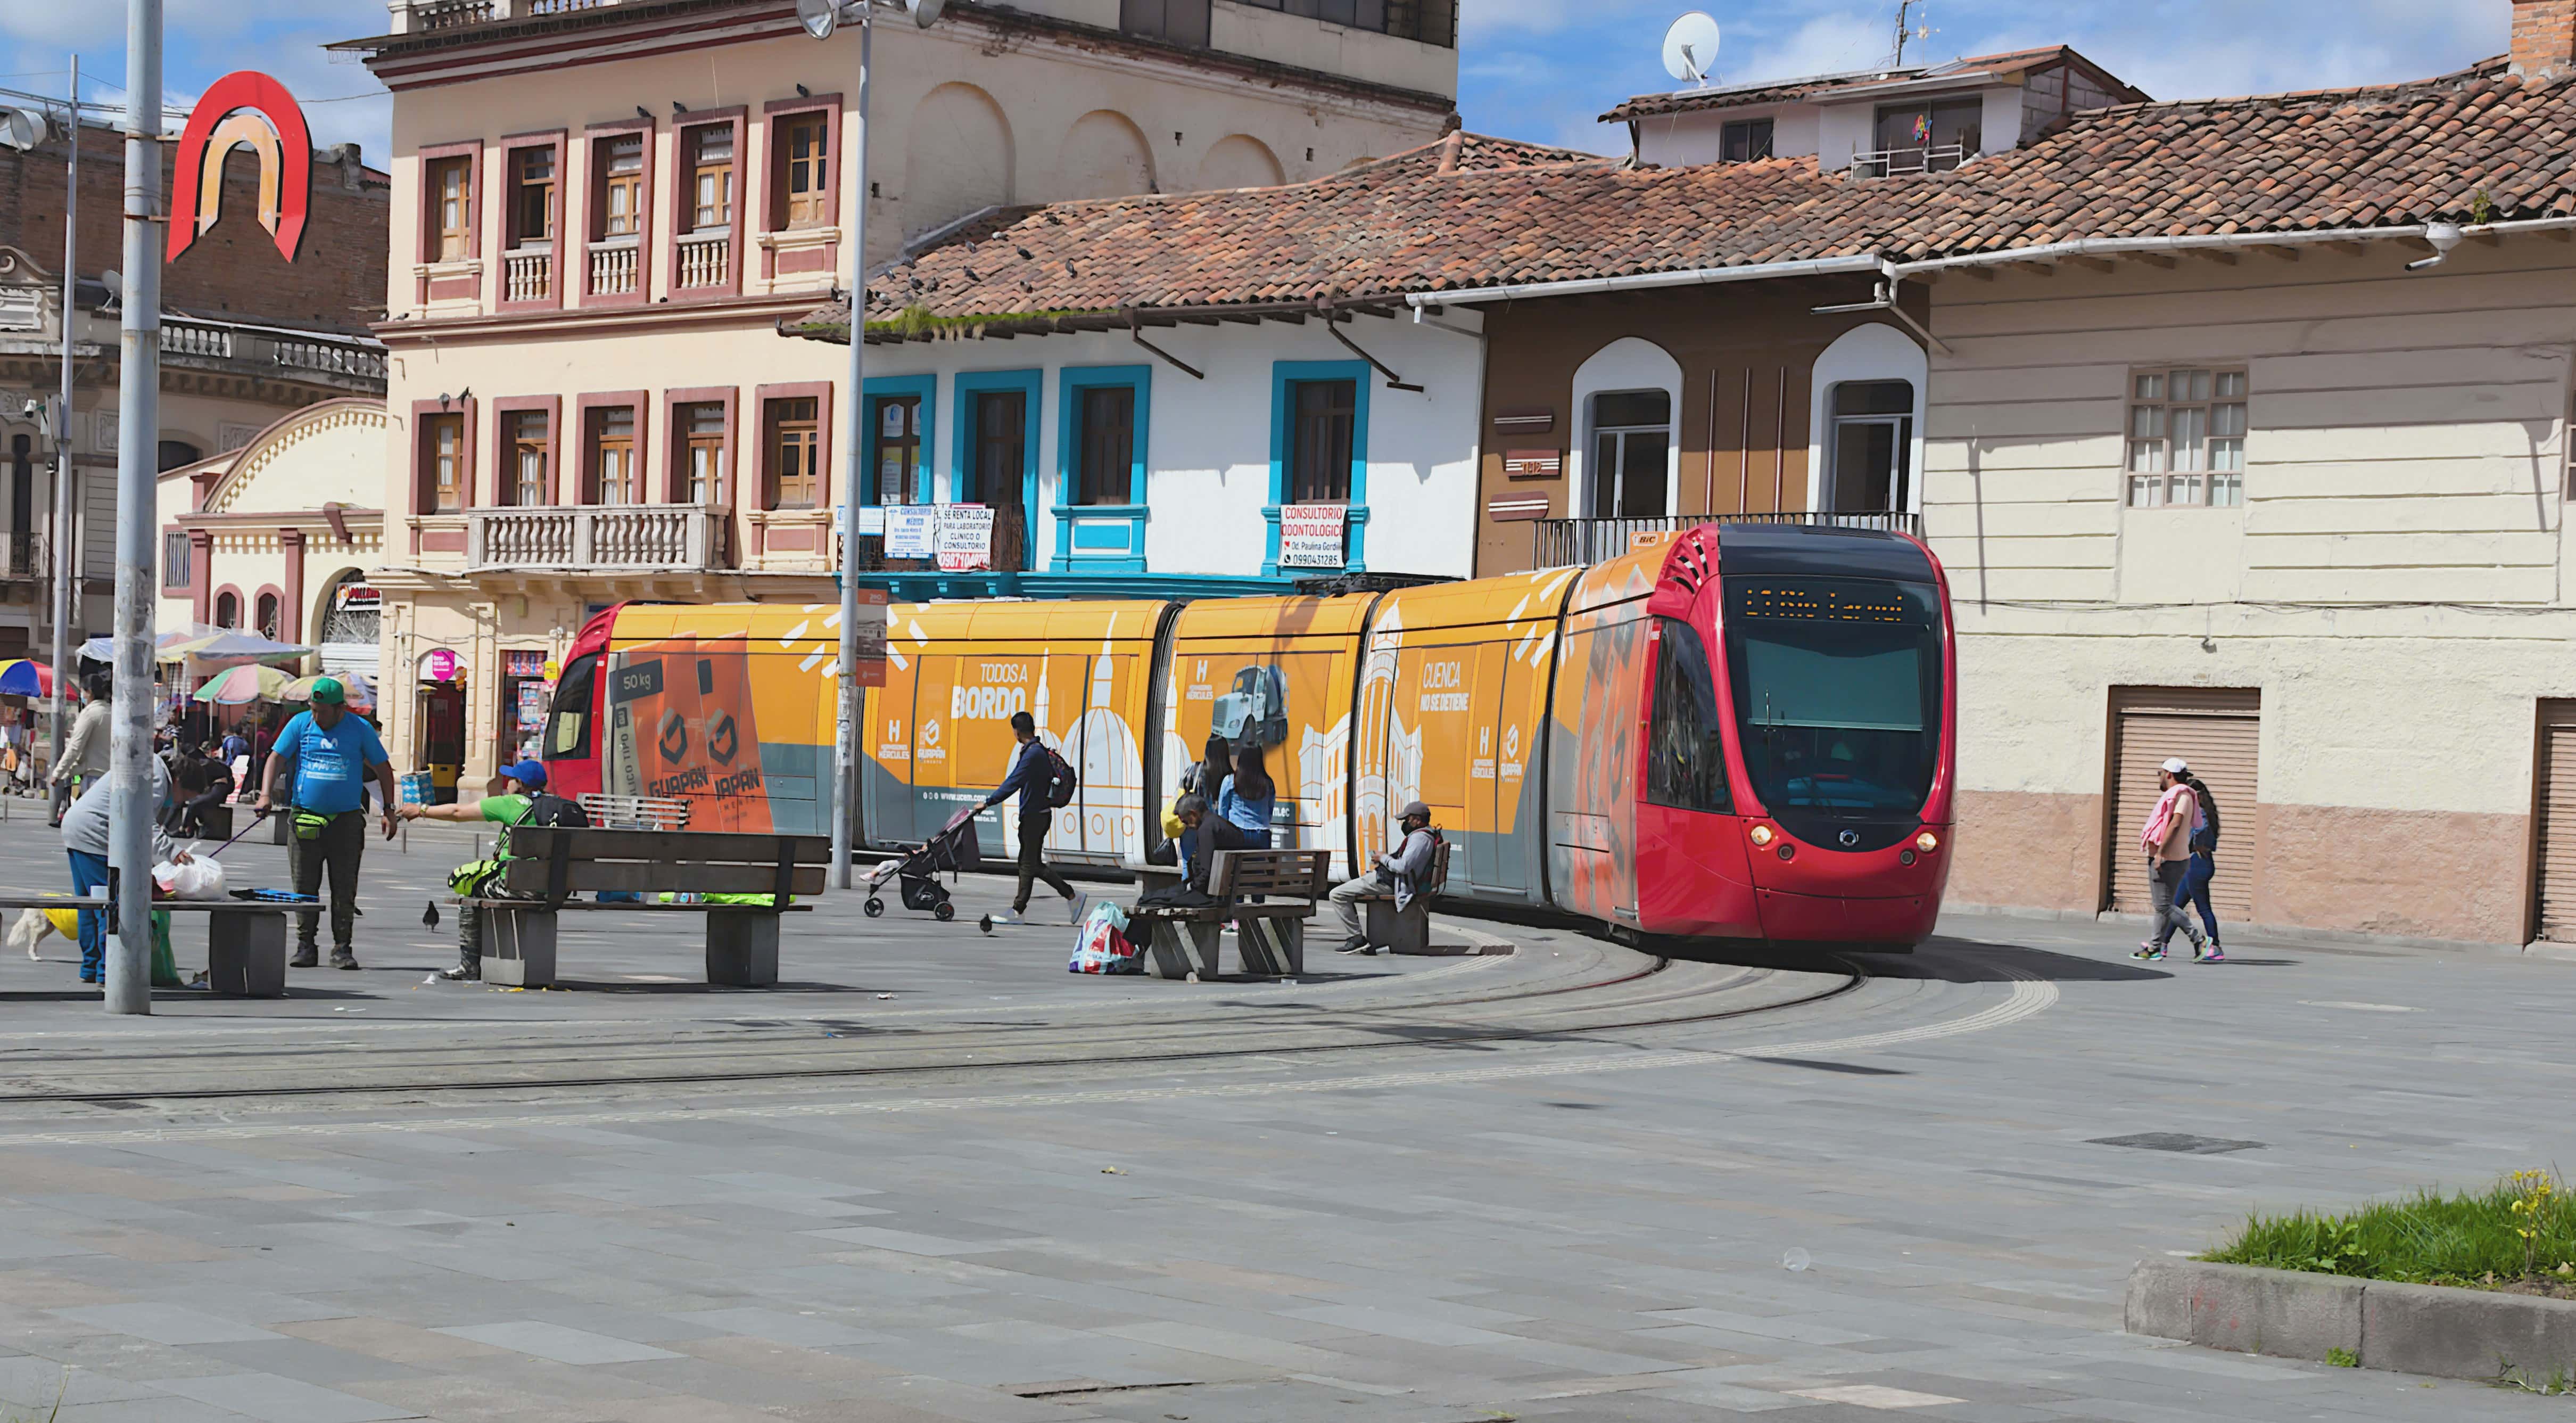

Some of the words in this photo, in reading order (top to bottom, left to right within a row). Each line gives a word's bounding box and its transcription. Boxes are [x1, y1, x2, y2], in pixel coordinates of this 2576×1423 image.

[945, 511, 951, 520] SE
[953, 511, 971, 520] RENTA
[972, 511, 992, 520] LOCAL
[1285, 507, 1342, 520] CONSULTORIO
[1293, 554, 1338, 565] 0990431285
[623, 674, 638, 690] 50
[639, 672, 651, 690] kg
[980, 663, 1019, 683] TODOS
[1019, 664, 1028, 682] A
[1423, 661, 1460, 688] CUENCA
[951, 685, 1026, 720] BORDO
[1420, 694, 1431, 711] NO
[1430, 693, 1439, 711] SE
